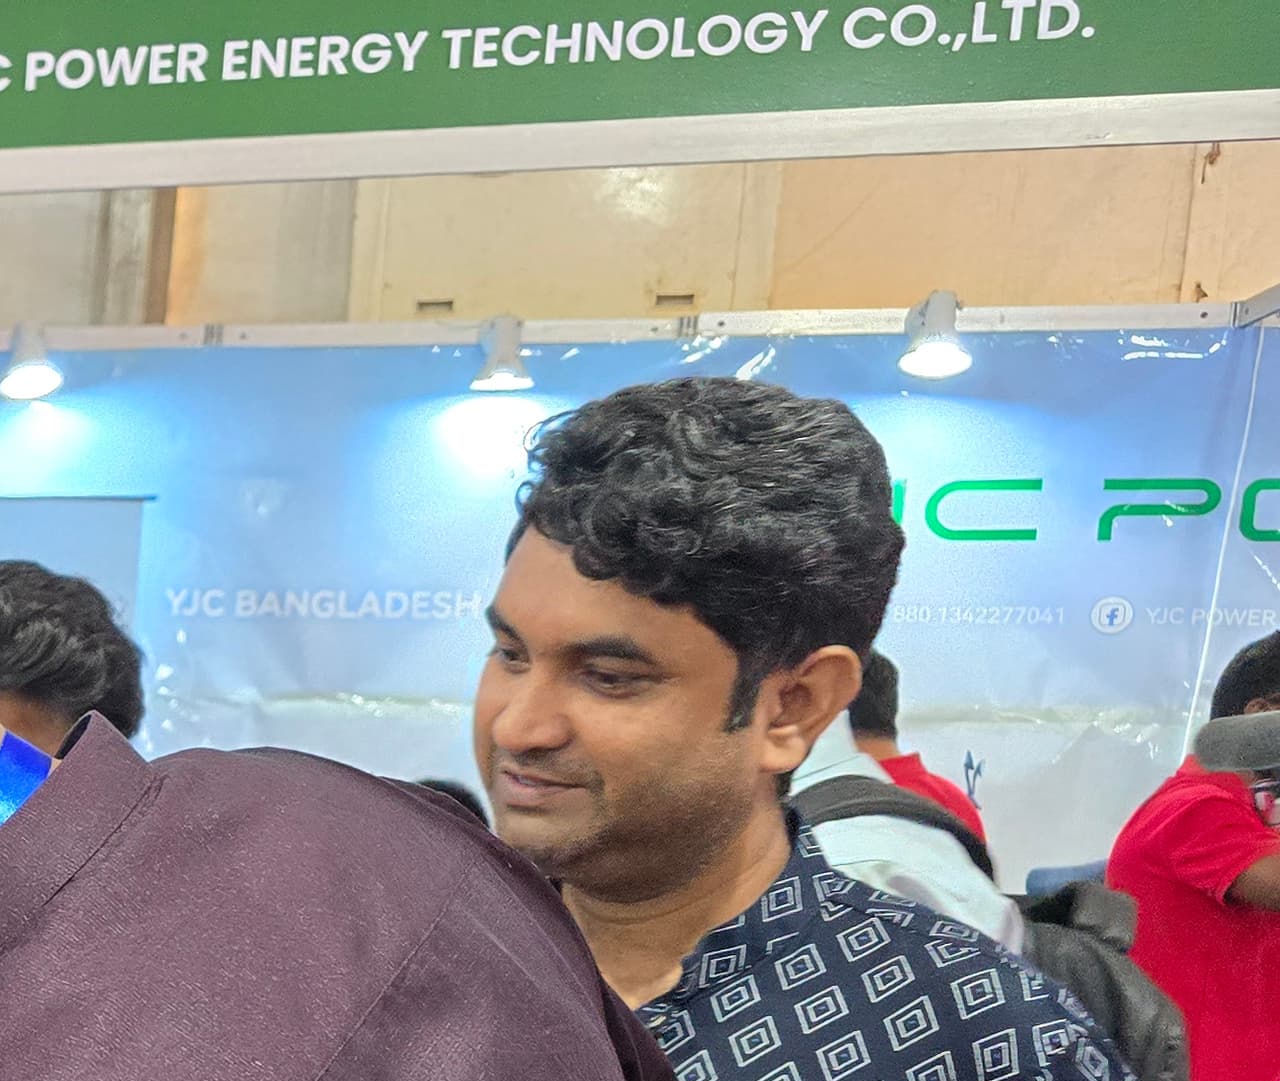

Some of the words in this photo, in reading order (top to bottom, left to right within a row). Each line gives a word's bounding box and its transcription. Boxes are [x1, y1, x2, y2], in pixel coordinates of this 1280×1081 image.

[24, 42, 209, 92] POWER
[221, 30, 429, 81] ENERGY
[441, 9, 830, 69] TECHNOLOGY
[841, 0, 1096, 52] CO.,LTD.
[165, 588, 229, 618] YJC
[234, 589, 482, 620] BANGLADESH
[1144, 607, 1185, 626] YJC
[1190, 608, 1278, 627] POWER
